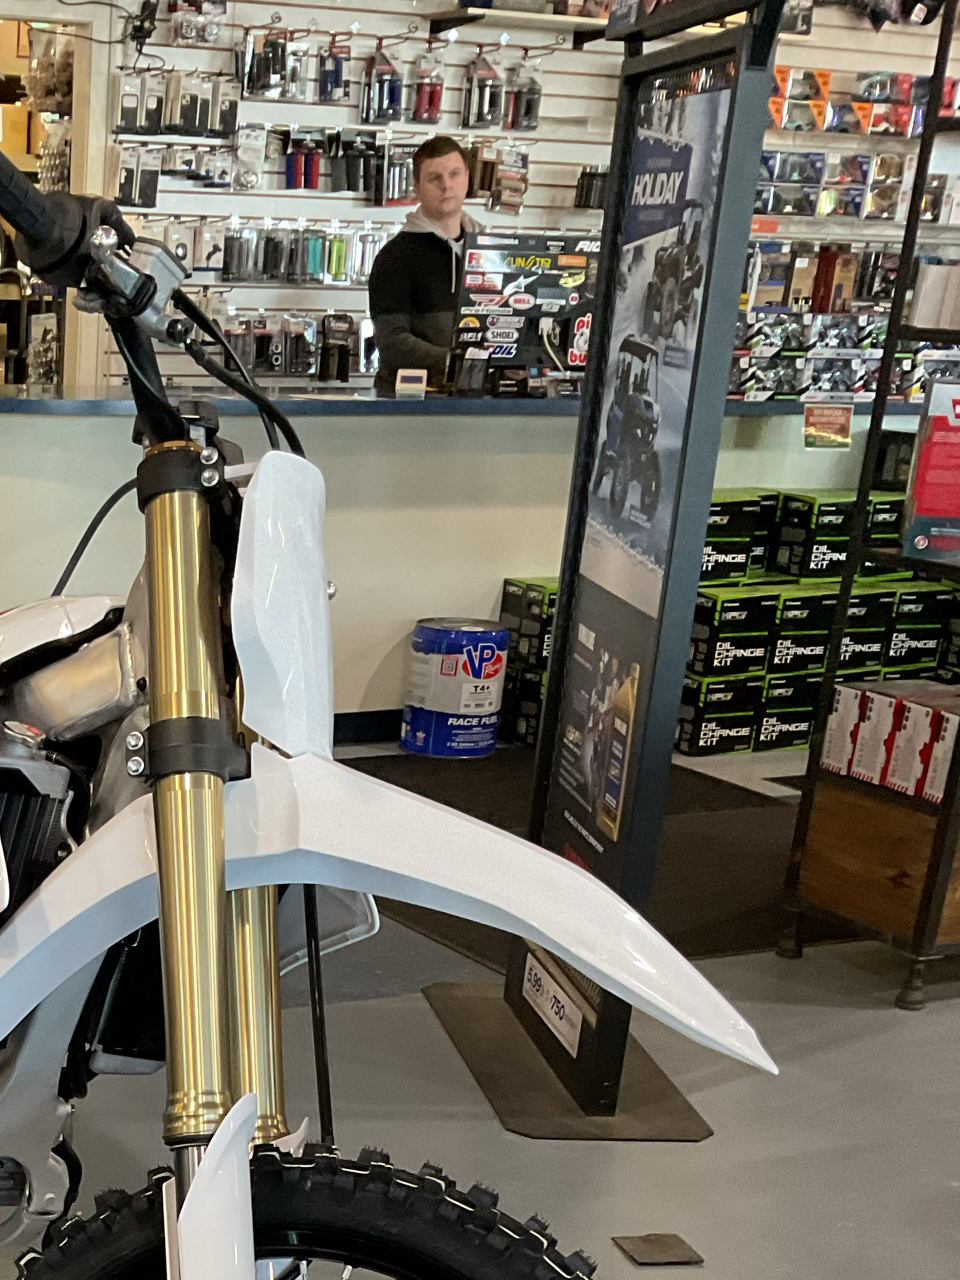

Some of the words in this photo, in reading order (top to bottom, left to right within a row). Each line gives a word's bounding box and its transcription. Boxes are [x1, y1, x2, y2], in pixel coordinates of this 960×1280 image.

[632, 171, 684, 206] HOLIDAY
[576, 314, 591, 332] pi
[491, 332, 515, 340] SHOEI
[703, 546, 716, 554] IL
[810, 561, 829, 569] KIT
[777, 640, 796, 648] OIL
[891, 640, 937, 648] CHANGE
[715, 648, 765, 658] CHANGE
[776, 646, 824, 656] CHANGE
[463, 643, 496, 679] VP
[713, 658, 733, 667] KIT
[774, 656, 793, 664] KIT
[448, 718, 480, 726] RACE
[763, 717, 781, 725] OIL
[702, 722, 720, 730] OIL
[761, 723, 809, 733] CHANGE
[701, 728, 750, 738] CHANGE
[760, 733, 779, 741] KIT
[699, 738, 719, 747] KIT
